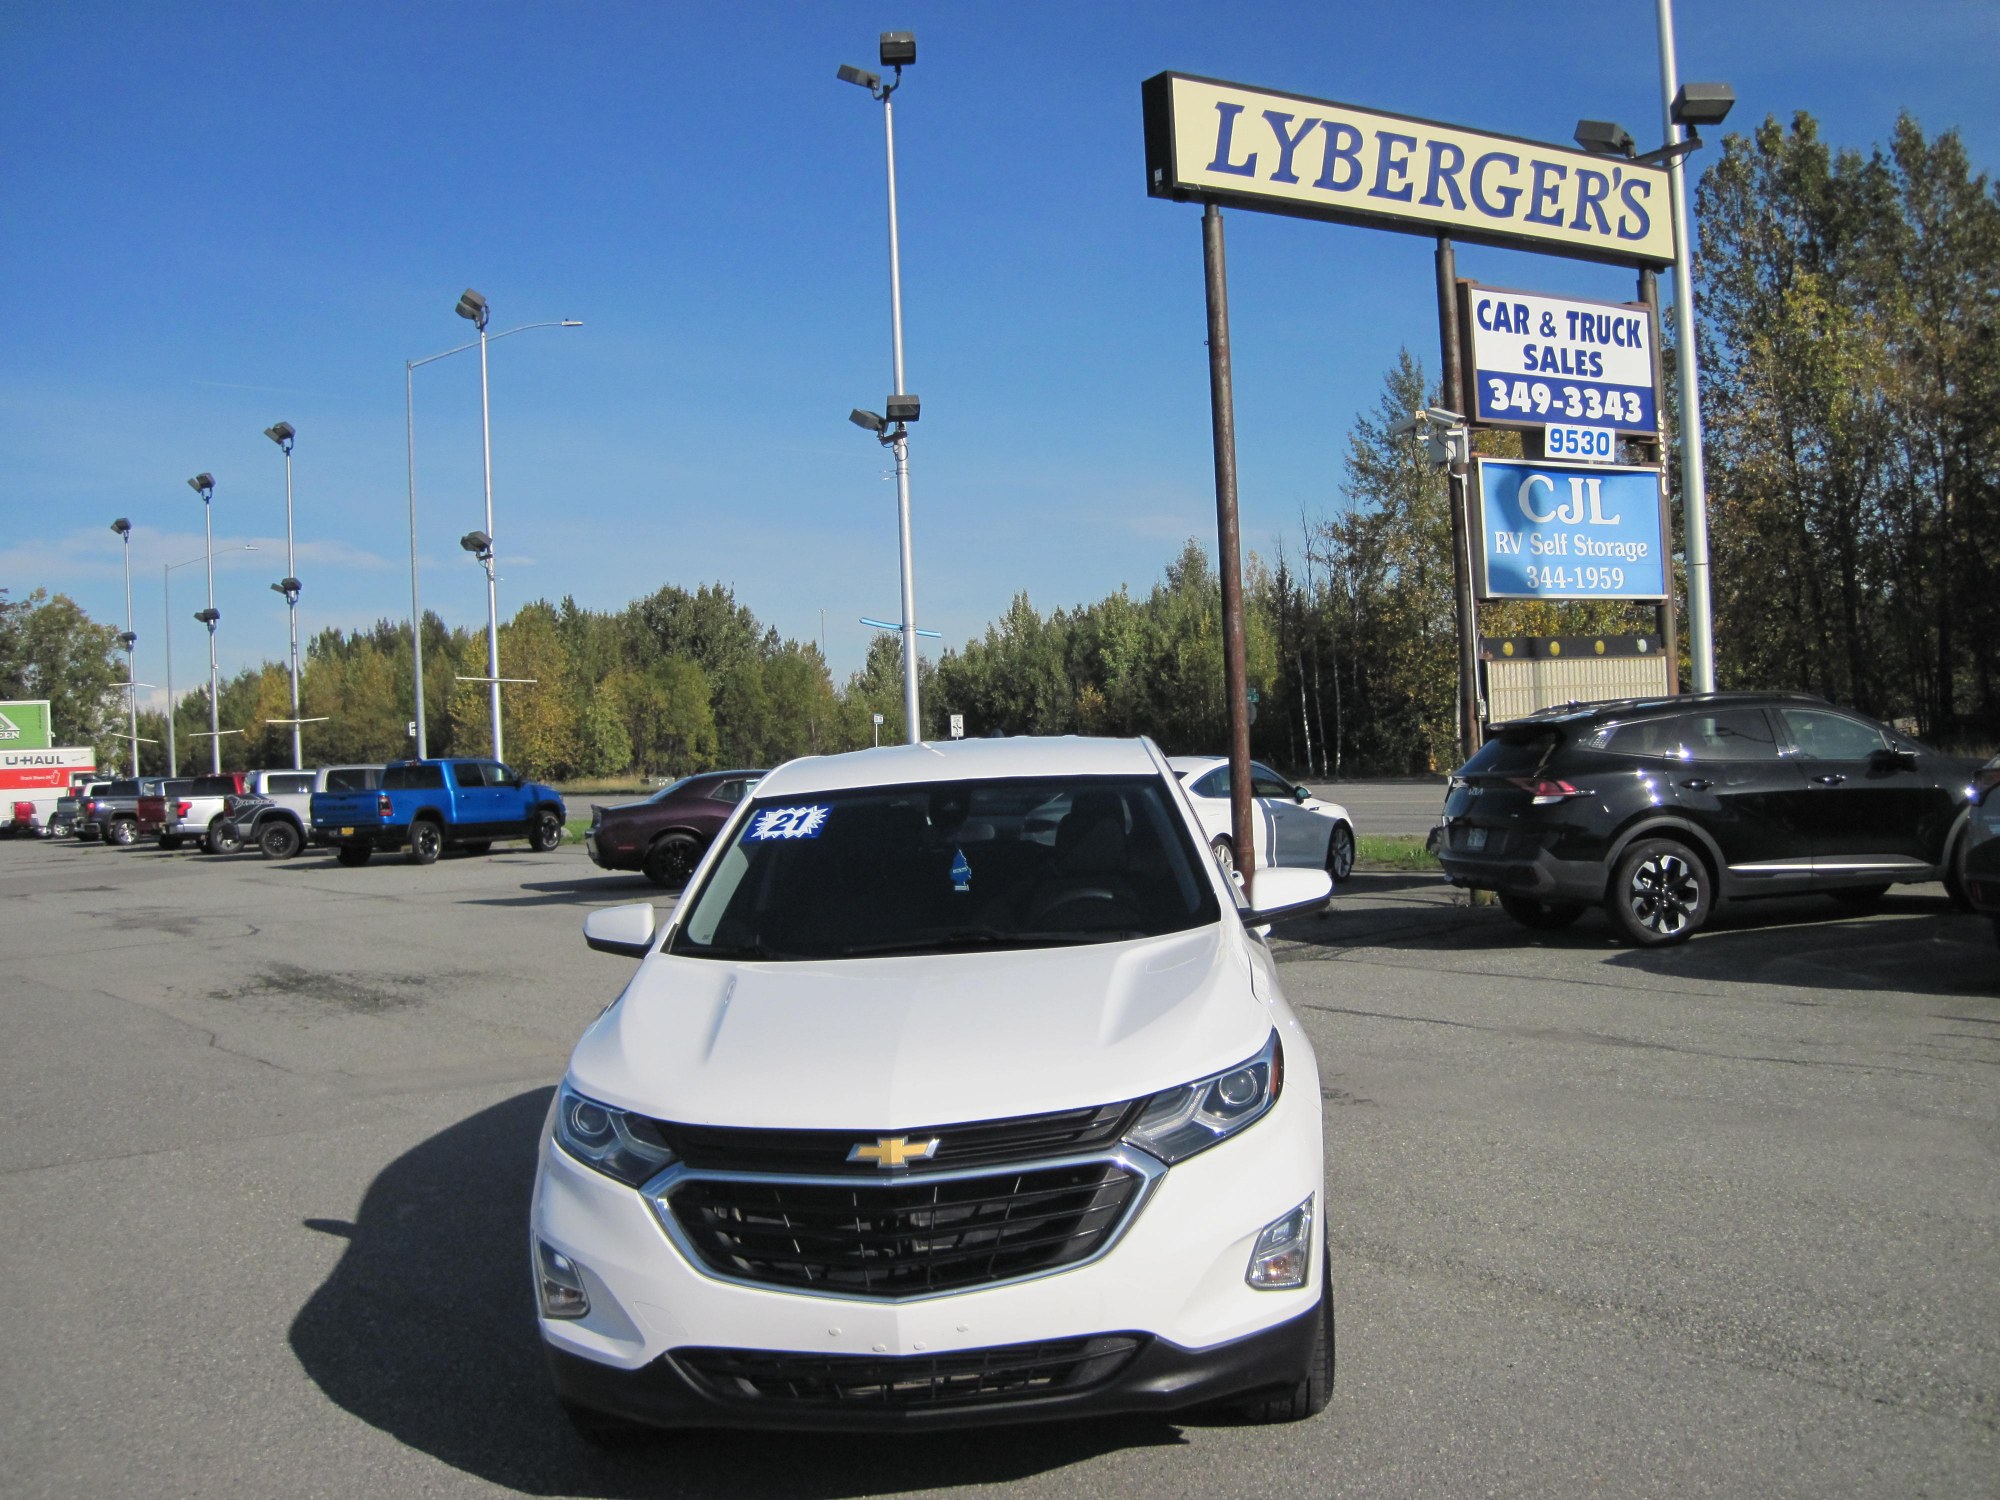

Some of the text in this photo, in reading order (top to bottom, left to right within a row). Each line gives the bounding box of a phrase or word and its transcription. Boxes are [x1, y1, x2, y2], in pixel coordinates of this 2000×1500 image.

[1205, 100, 1652, 241] LYBERGER'S
[1476, 298, 1643, 349] CAR & TRUCK
[1522, 343, 1604, 379] SALES
[1487, 378, 1643, 423] 349-3343
[1549, 428, 1610, 456] 9530
[1518, 474, 1621, 525] CJL
[1494, 531, 1648, 562] RV Self Storage
[1526, 565, 1625, 590] 344-1959
[5, 755, 64, 765] U-HAUL
[767, 812, 812, 832] 21
